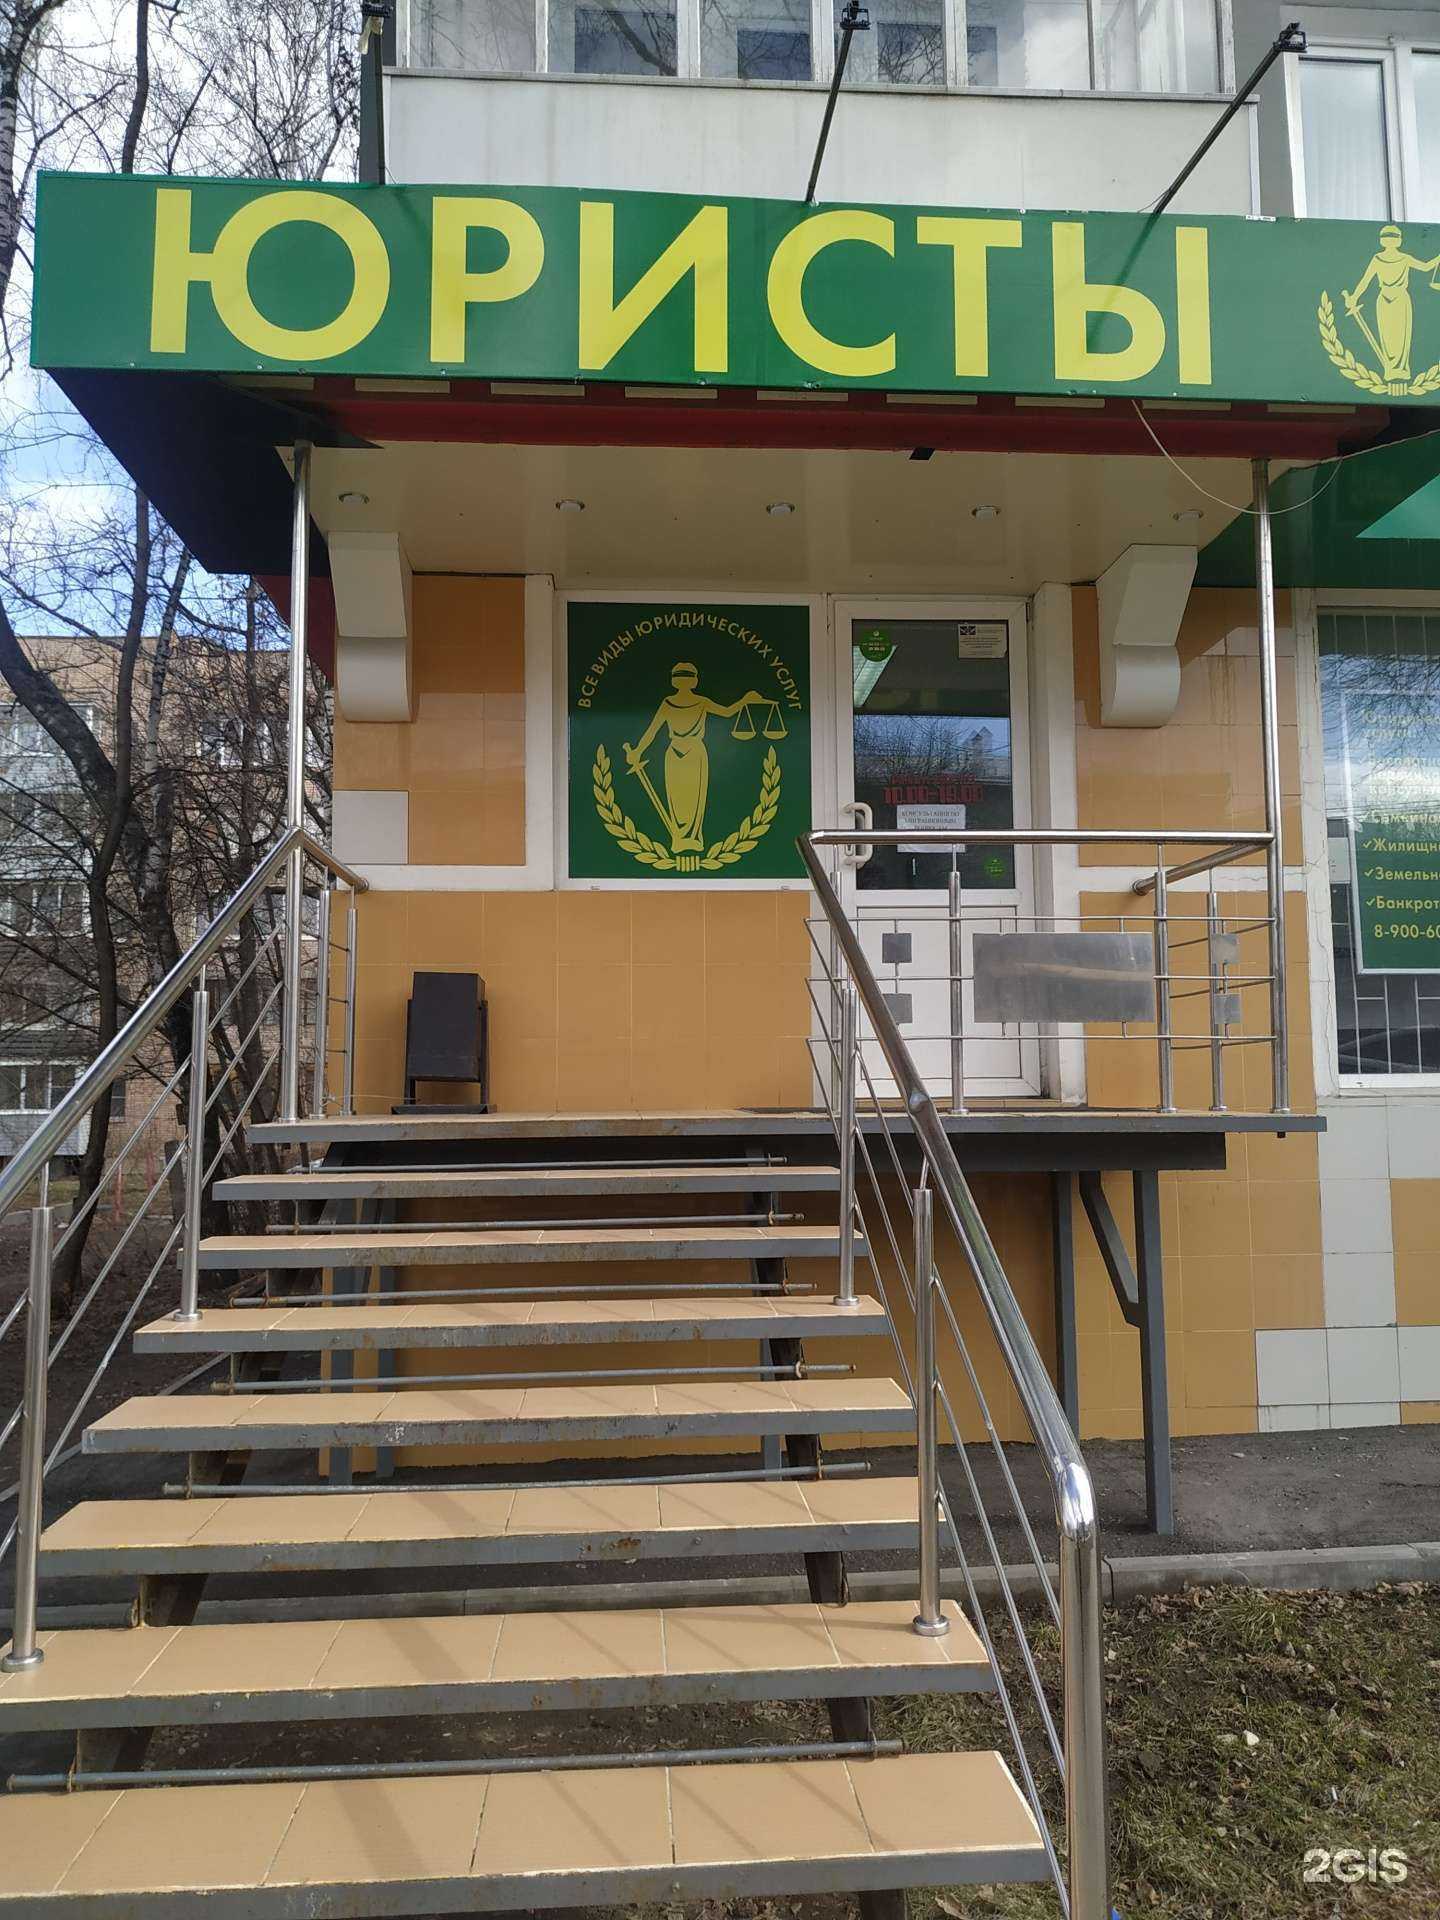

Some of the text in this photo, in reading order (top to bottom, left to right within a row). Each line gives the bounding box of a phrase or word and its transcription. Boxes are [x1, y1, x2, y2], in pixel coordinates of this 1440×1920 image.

[150, 188, 1212, 385] ЮРИСТЫ
[578, 612, 802, 710] ВСЕ ВИДЫ ЮРИДИЧЕСКИХ УСЛУГ
[1373, 838, 1440, 853] Жилищн
[1375, 867, 1440, 880] Земельн
[1376, 896, 1440, 913] Банкрот
